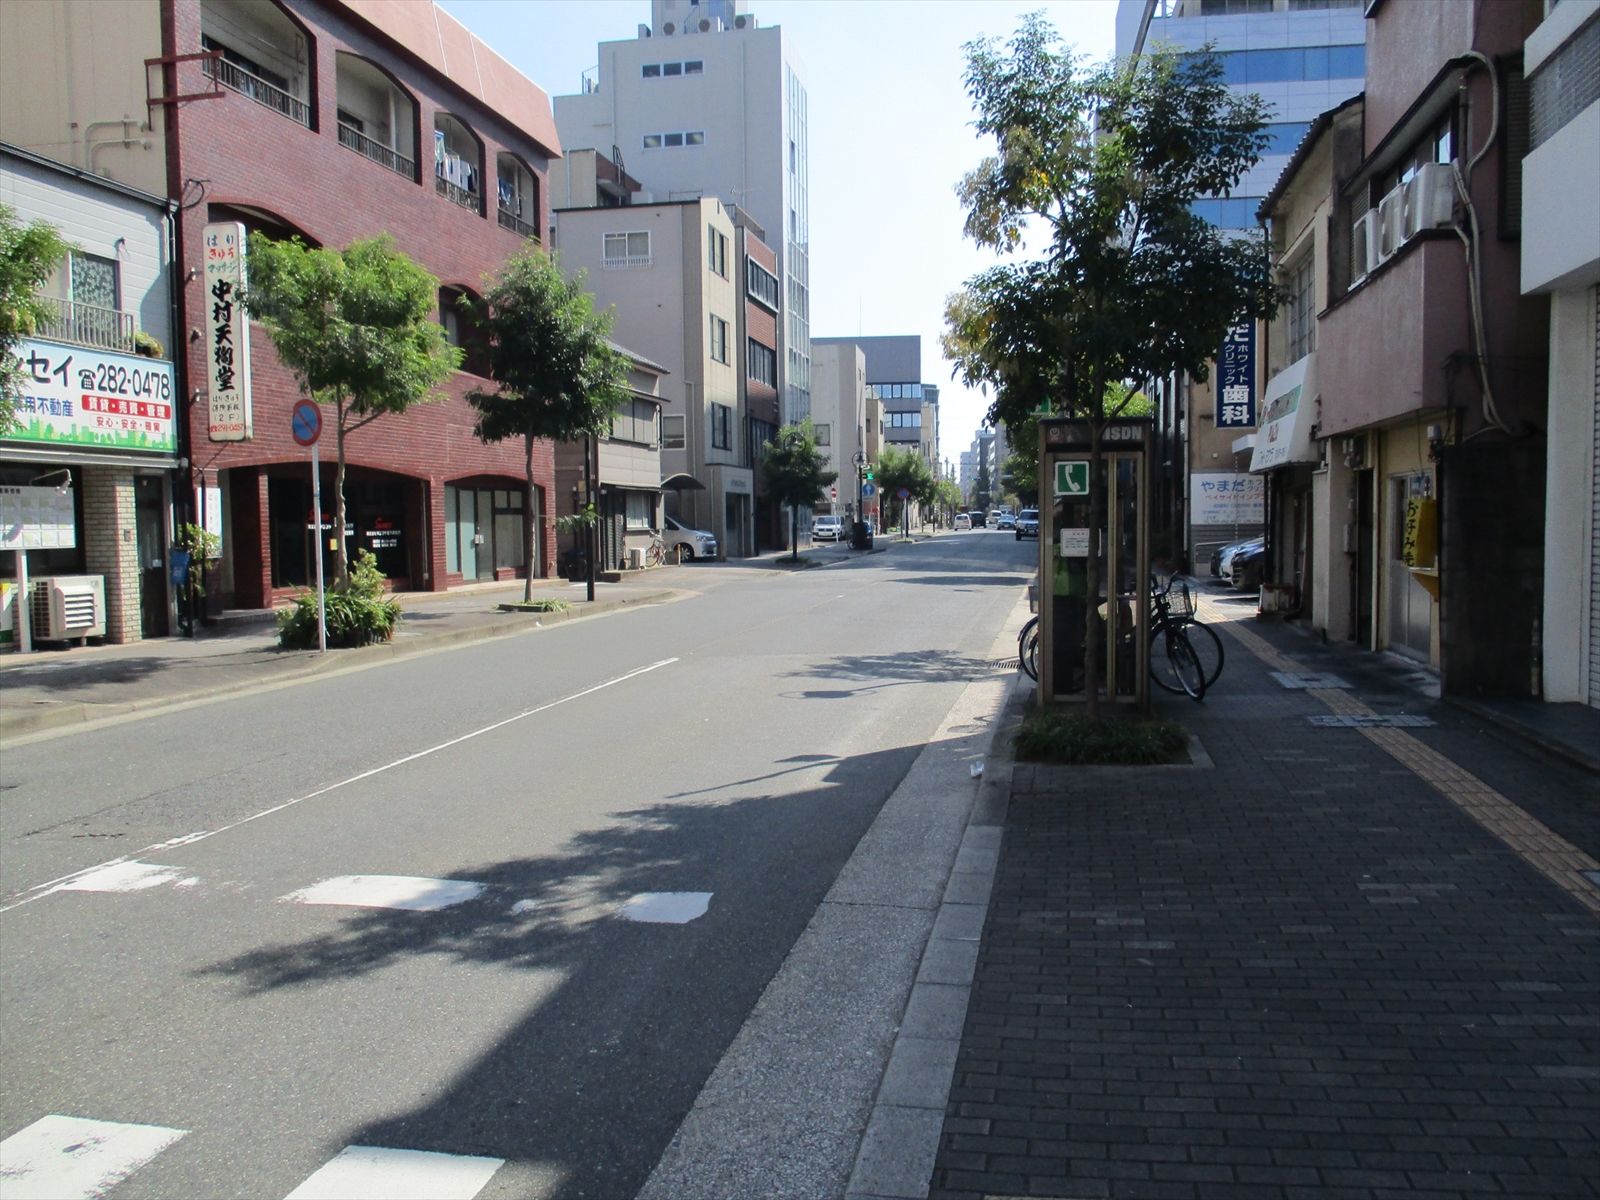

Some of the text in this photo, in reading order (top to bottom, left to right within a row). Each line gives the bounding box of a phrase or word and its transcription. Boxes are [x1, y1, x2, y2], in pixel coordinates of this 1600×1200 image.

[207, 234, 234, 247] はり
[208, 247, 234, 260] きゅう
[1224, 345, 1235, 384] クリニック
[1237, 345, 1249, 383] ホワイト
[1222, 384, 1250, 424] 歯科
[1200, 479, 1246, 493] やまだ
